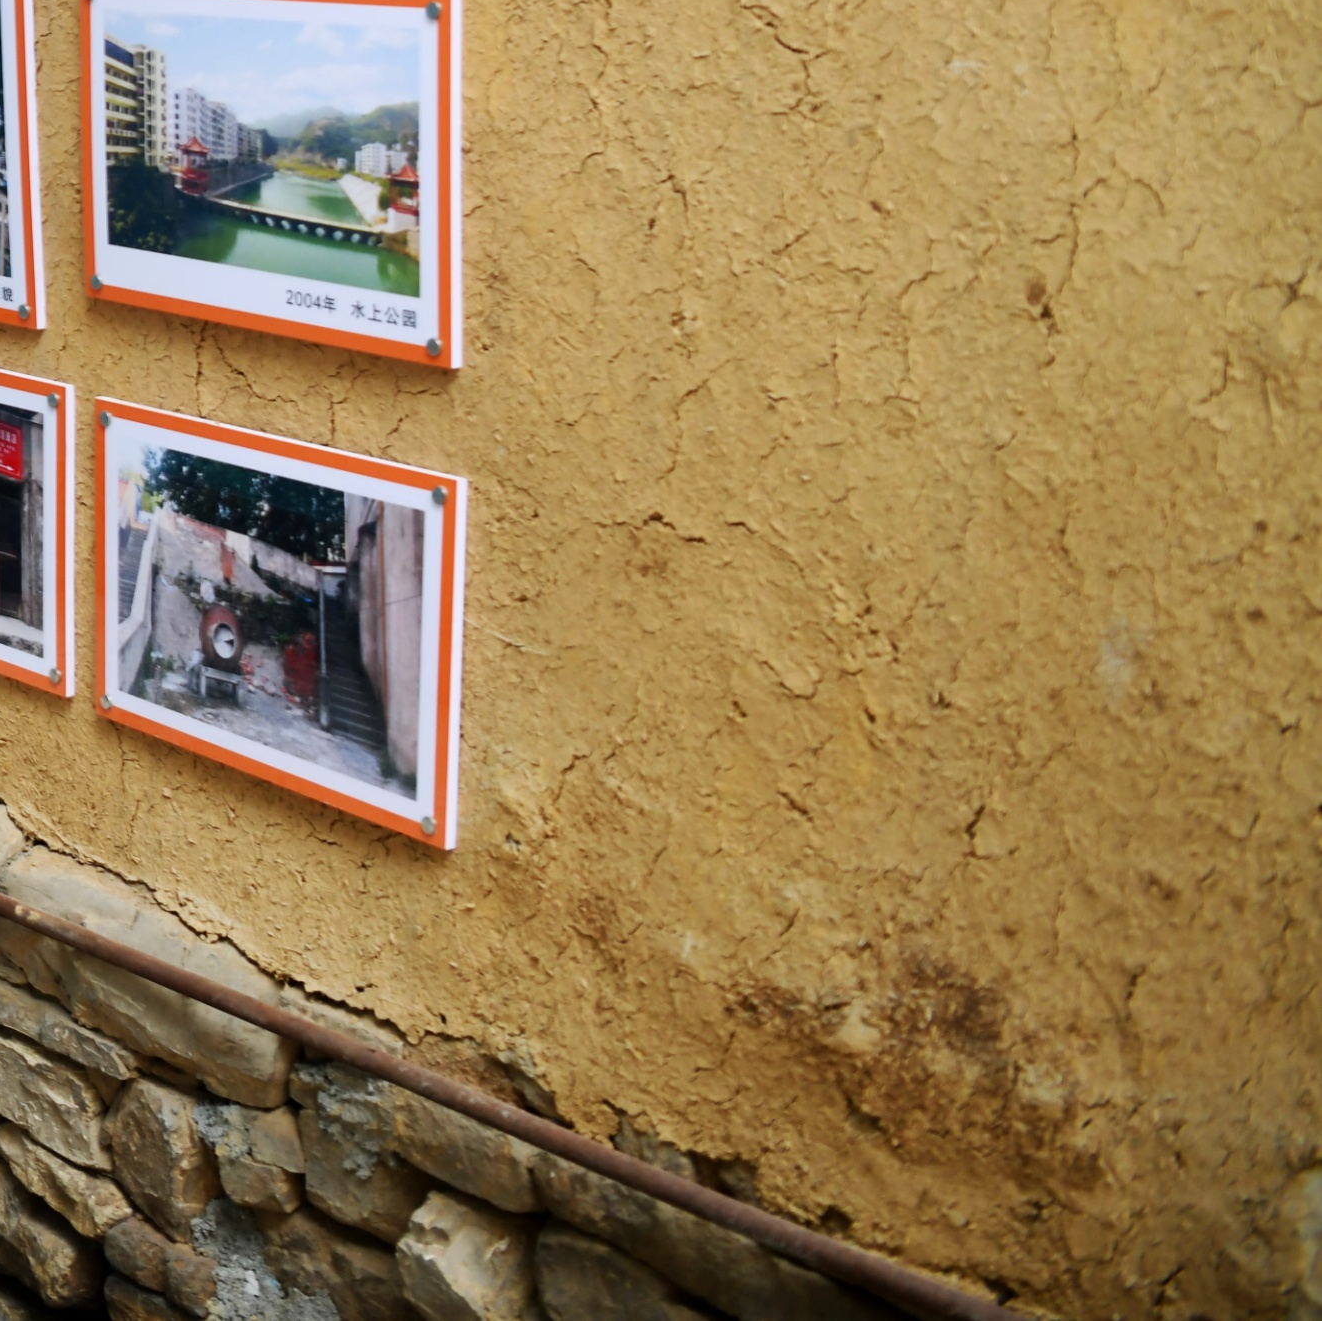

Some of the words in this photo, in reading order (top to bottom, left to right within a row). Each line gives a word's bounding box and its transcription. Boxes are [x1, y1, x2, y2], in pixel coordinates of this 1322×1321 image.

[286, 289, 336, 313] 2004年
[350, 300, 417, 328] 水上公园
